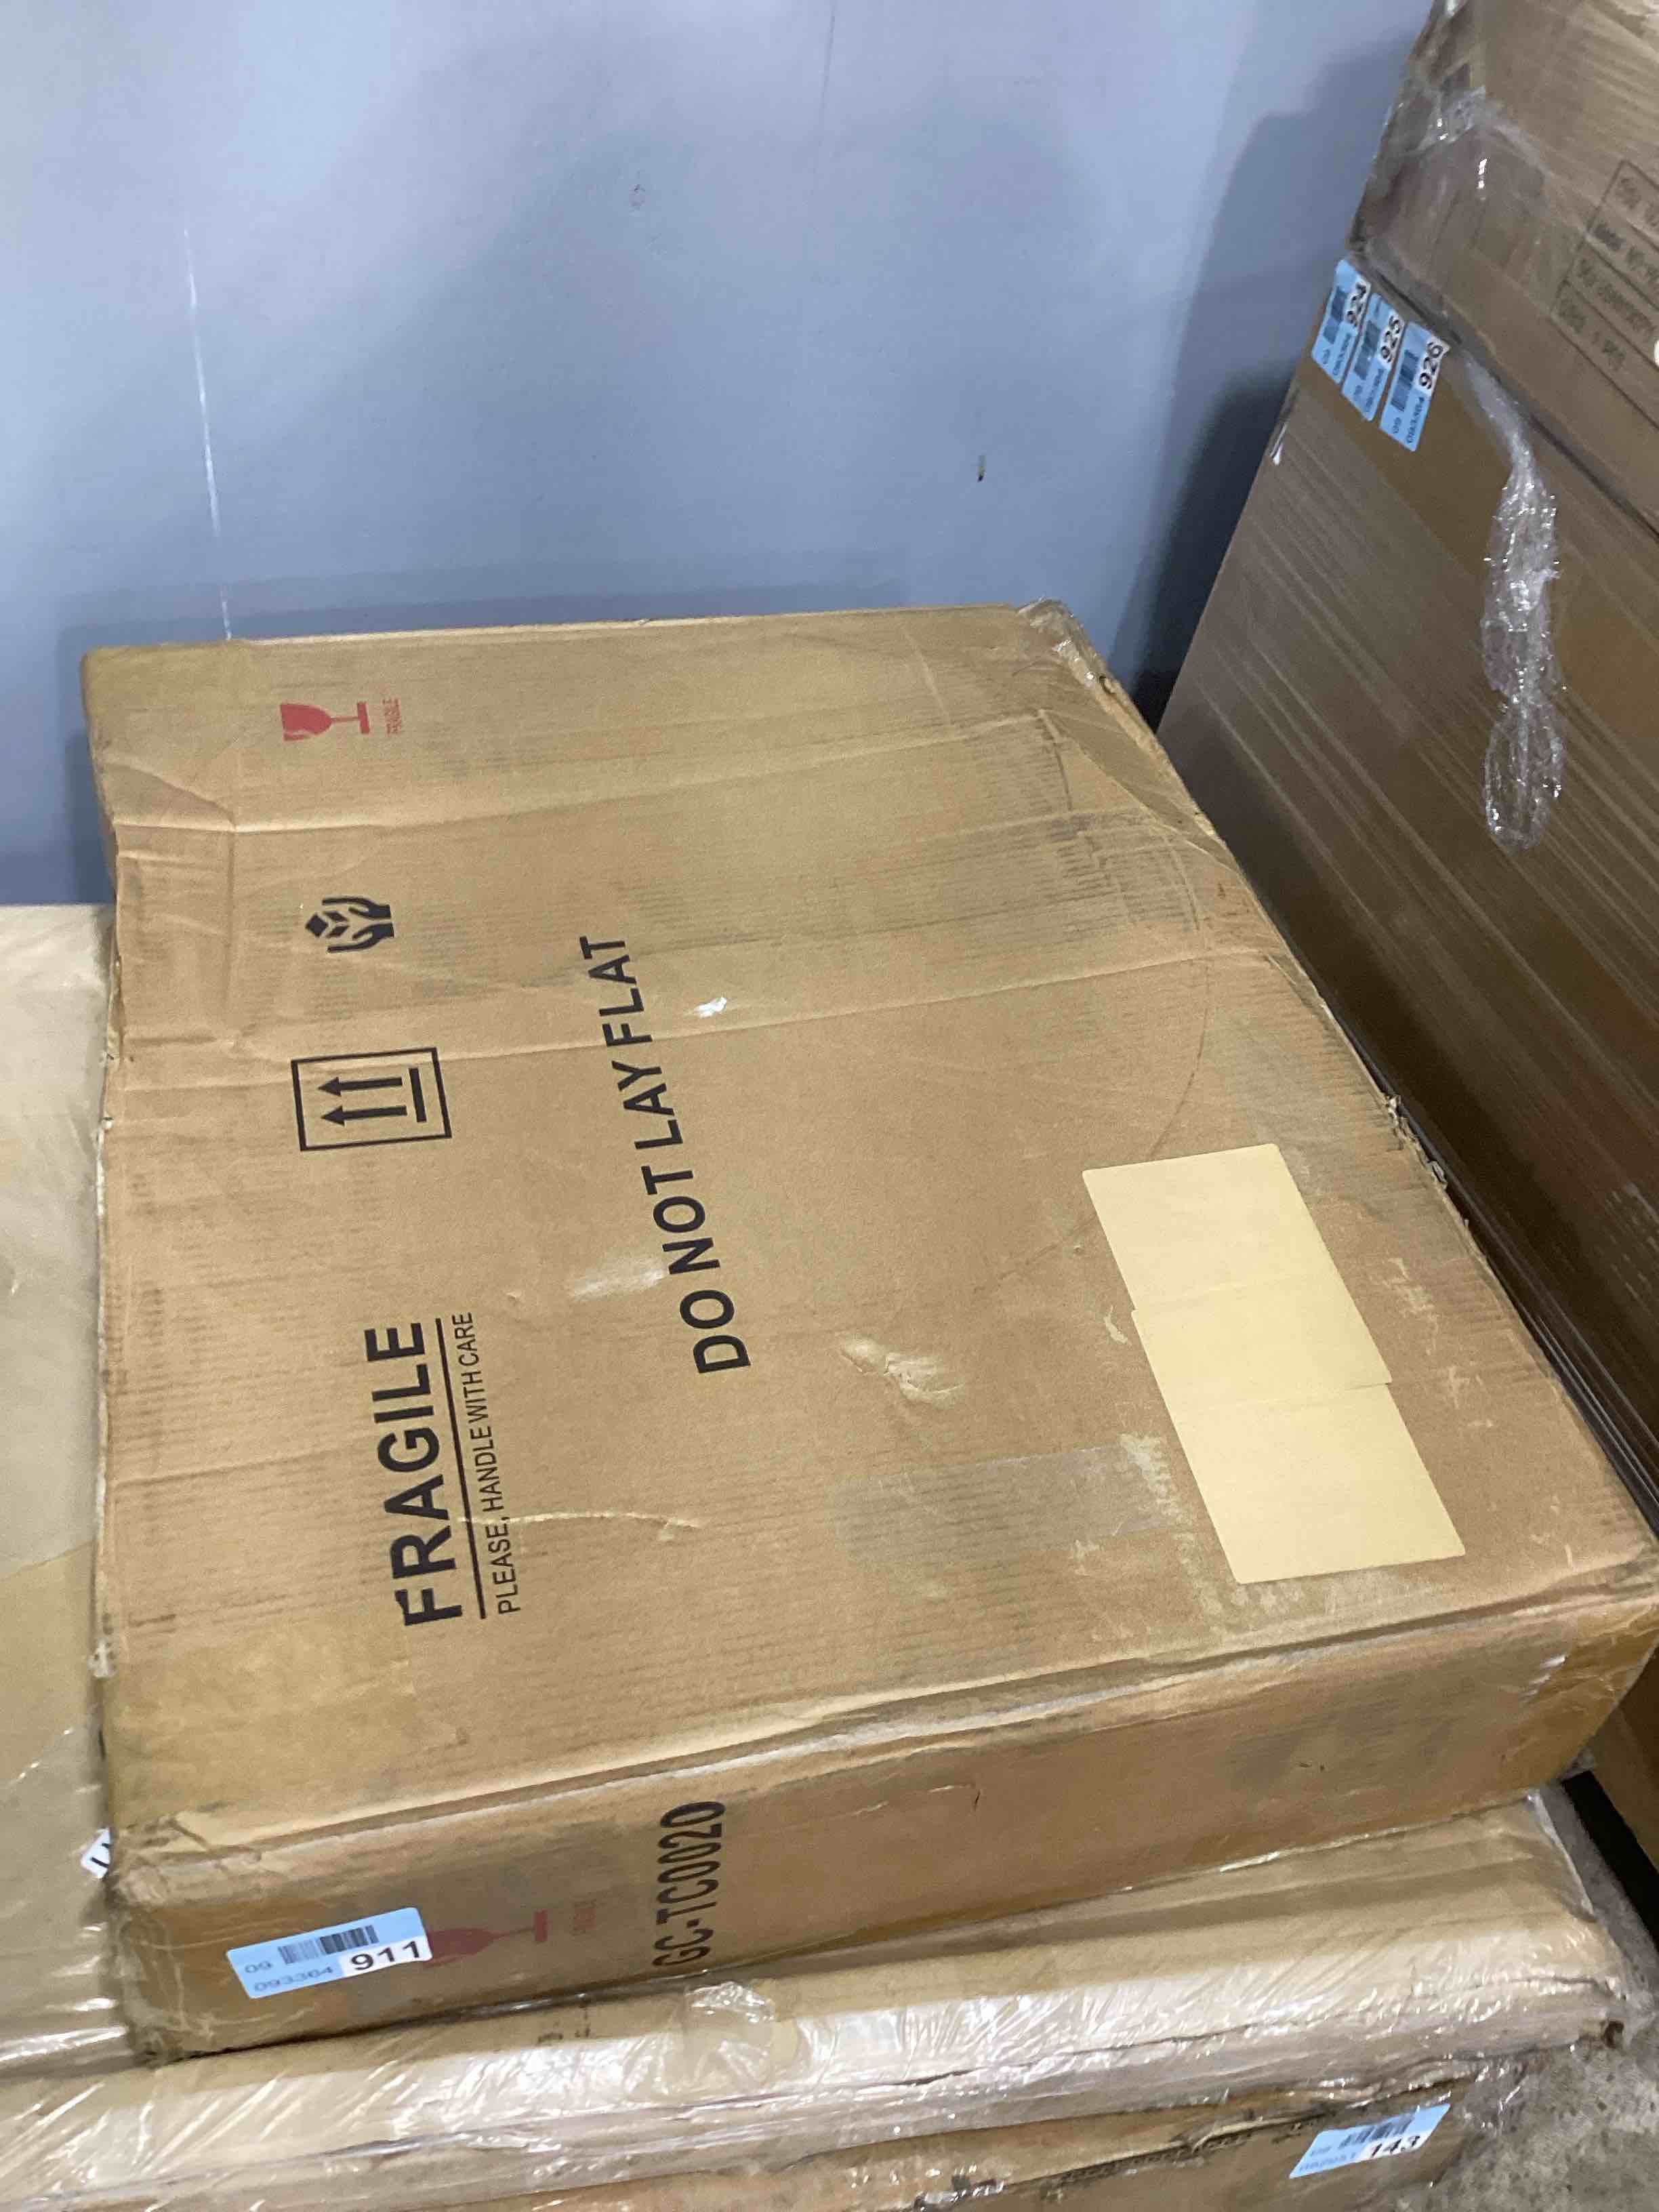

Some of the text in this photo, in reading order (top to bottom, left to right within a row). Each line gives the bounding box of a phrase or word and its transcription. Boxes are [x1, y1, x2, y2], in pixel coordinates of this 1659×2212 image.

[1380, 314, 1401, 363] 925
[1419, 341, 1443, 390] 926
[579, 935, 751, 1374] DO NOT LAY FLAT
[364, 1322, 463, 1626] FRAGILE
[452, 1312, 520, 1615] PLEASE, HANDLE WITH CARE
[351, 1941, 420, 1970] 911
[652, 1801, 726, 1966] GC-TC0020
